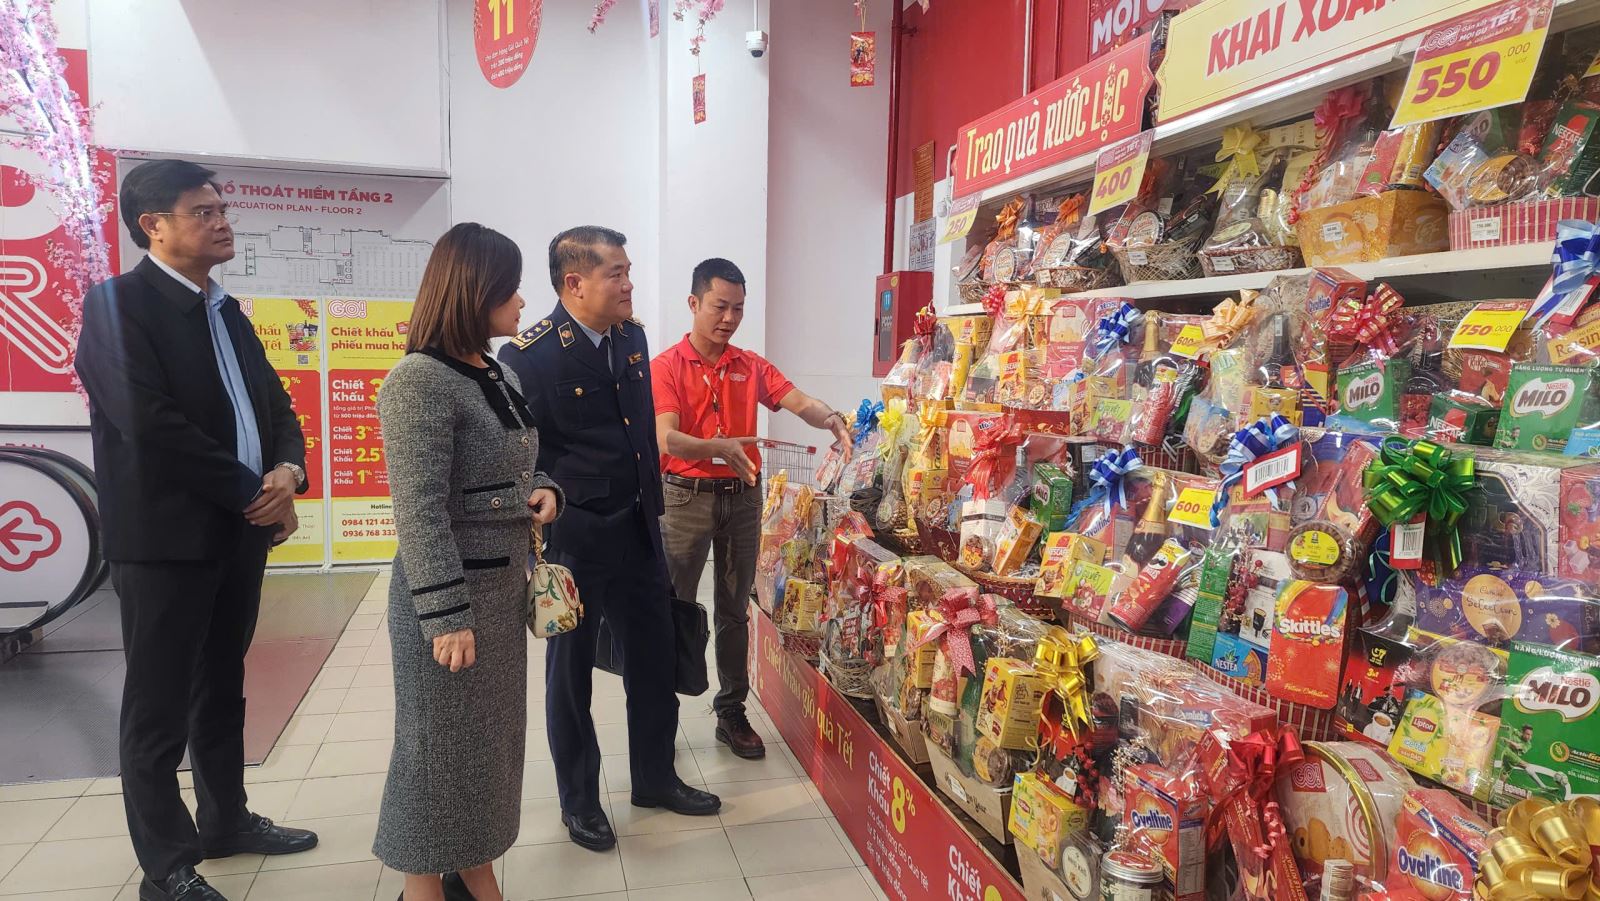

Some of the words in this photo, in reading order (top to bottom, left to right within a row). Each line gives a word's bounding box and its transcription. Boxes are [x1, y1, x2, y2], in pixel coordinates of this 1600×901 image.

[1489, 4, 1521, 29] TẾT
[1207, 1, 1287, 77] KHAI
[1291, 0, 1395, 42] XU
[1411, 51, 1501, 104] 550
[966, 128, 1004, 180] Trao
[1096, 166, 1132, 199] 400
[239, 184, 294, 198] THOÁT
[297, 184, 335, 201] HIỂM
[338, 187, 381, 203] TẦNG
[383, 193, 393, 203] 2
[225, 200, 284, 211] VACUATION
[286, 204, 312, 213] PLAN
[321, 206, 354, 214] FLOOR
[356, 207, 362, 215] 2
[328, 300, 368, 319] GO!
[331, 325, 363, 337] Chiết
[365, 325, 394, 338] khấu
[1459, 324, 1492, 336] 750
[263, 338, 282, 351] Tết
[331, 338, 362, 351] phiếu
[365, 342, 390, 350] mua
[332, 378, 364, 390] Chiết
[1349, 382, 1380, 404] MILO
[332, 391, 365, 402] Khấu
[1518, 390, 1567, 407] MILO
[333, 425, 352, 433] Chiết
[355, 425, 373, 440] 3%
[357, 469, 372, 484] 1%
[1176, 501, 1200, 514] 600
[343, 530, 363, 538] 0936
[1279, 617, 1340, 638] Skittles
[1371, 647, 1387, 660] G7
[1215, 658, 1239, 672] NESTEA
[1528, 680, 1591, 708] MILO
[1414, 718, 1435, 731] Lipton
[816, 707, 834, 744] quà
[836, 722, 853, 770] Tết
[868, 751, 891, 791] Chiết
[1291, 762, 1323, 789] GO!
[868, 774, 890, 817] Khấu
[891, 776, 916, 833] 8%
[1131, 809, 1173, 832] Ovaltine
[908, 855, 920, 879] Quà
[949, 844, 982, 899] Chiết
[1398, 846, 1464, 890] Ovaltine
